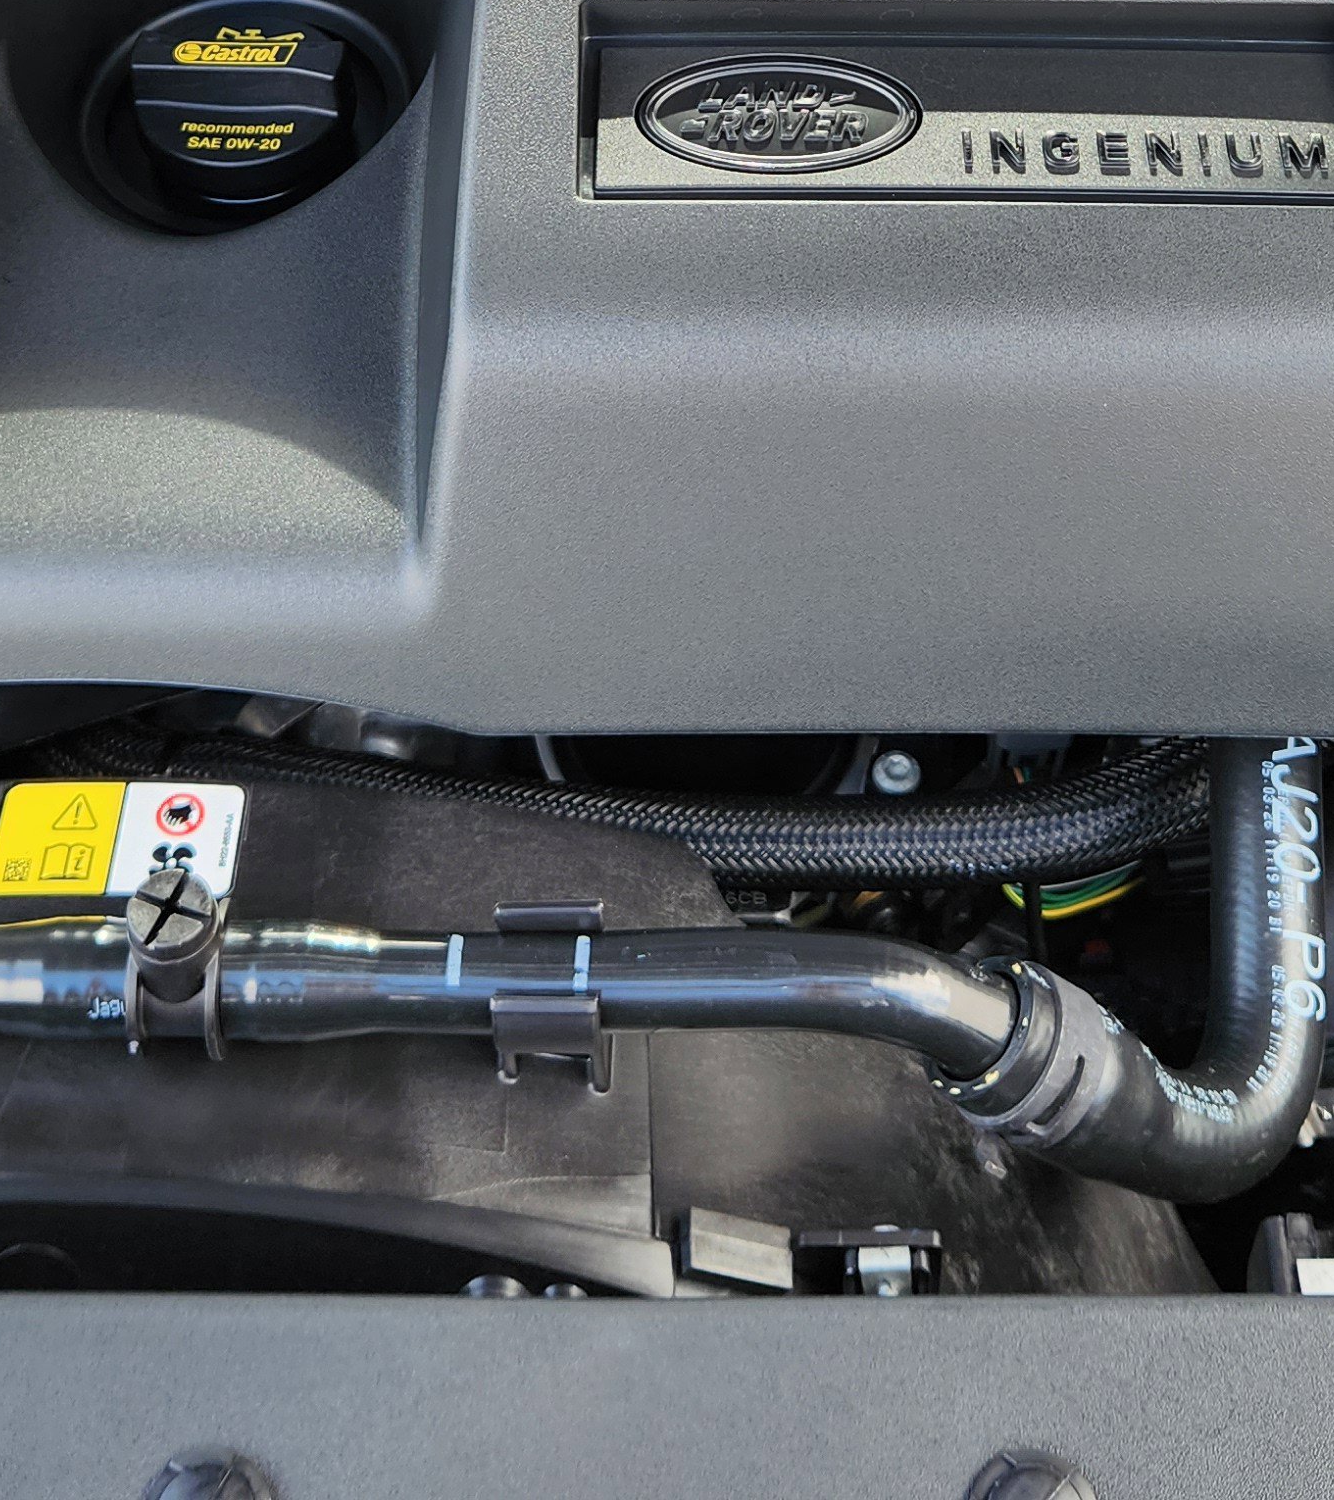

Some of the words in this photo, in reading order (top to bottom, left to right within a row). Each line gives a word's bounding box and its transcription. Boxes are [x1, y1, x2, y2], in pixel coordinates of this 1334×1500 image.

[201, 44, 277, 62] Castrol
[698, 81, 825, 112] LAND
[181, 121, 294, 134] recommended
[708, 109, 868, 143] ROVER
[187, 136, 222, 149] SAE
[226, 138, 281, 150] 0W-20
[961, 129, 1330, 178] INGENIUM
